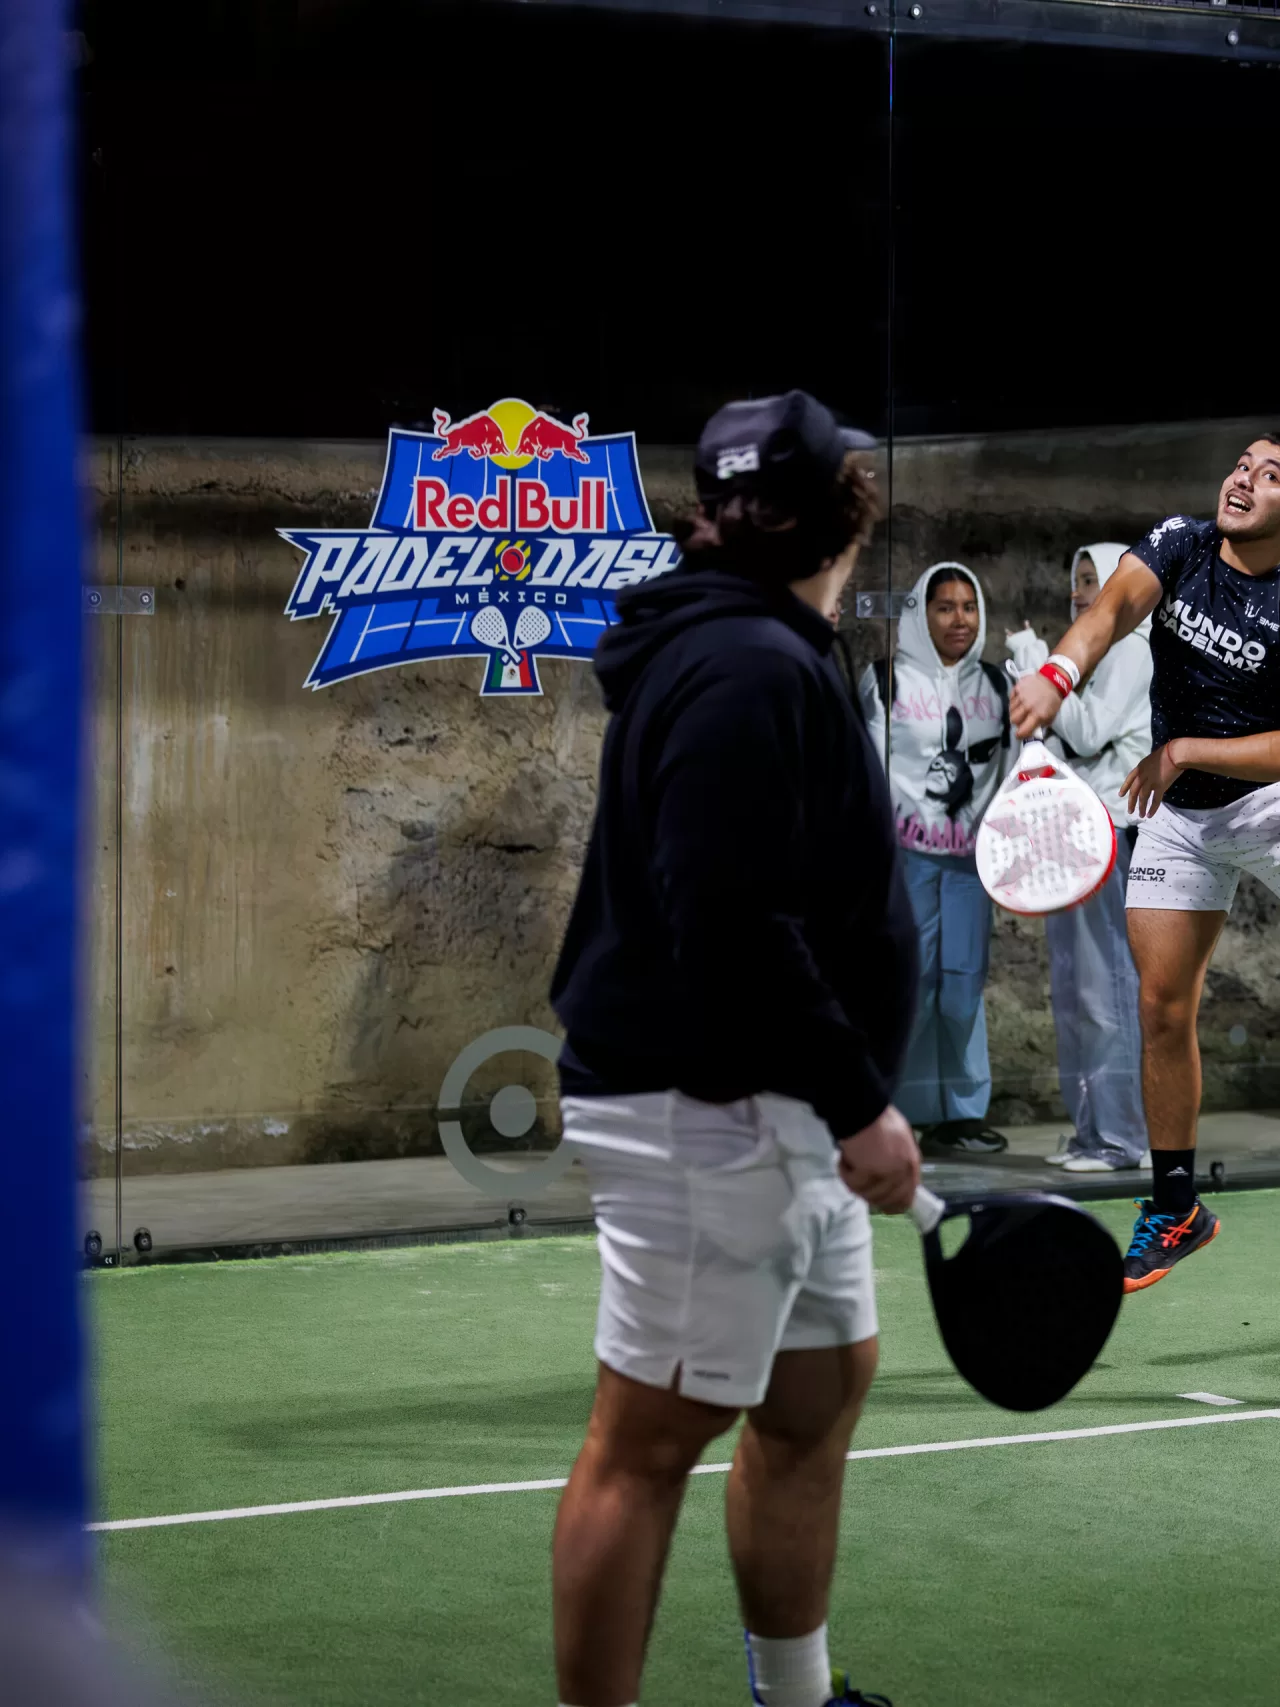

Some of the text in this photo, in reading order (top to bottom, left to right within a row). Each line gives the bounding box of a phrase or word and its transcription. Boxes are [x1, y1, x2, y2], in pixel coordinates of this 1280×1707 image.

[415, 479, 606, 530] Red Bull
[297, 536, 496, 605] PADEL
[455, 587, 567, 605] MÉXICO
